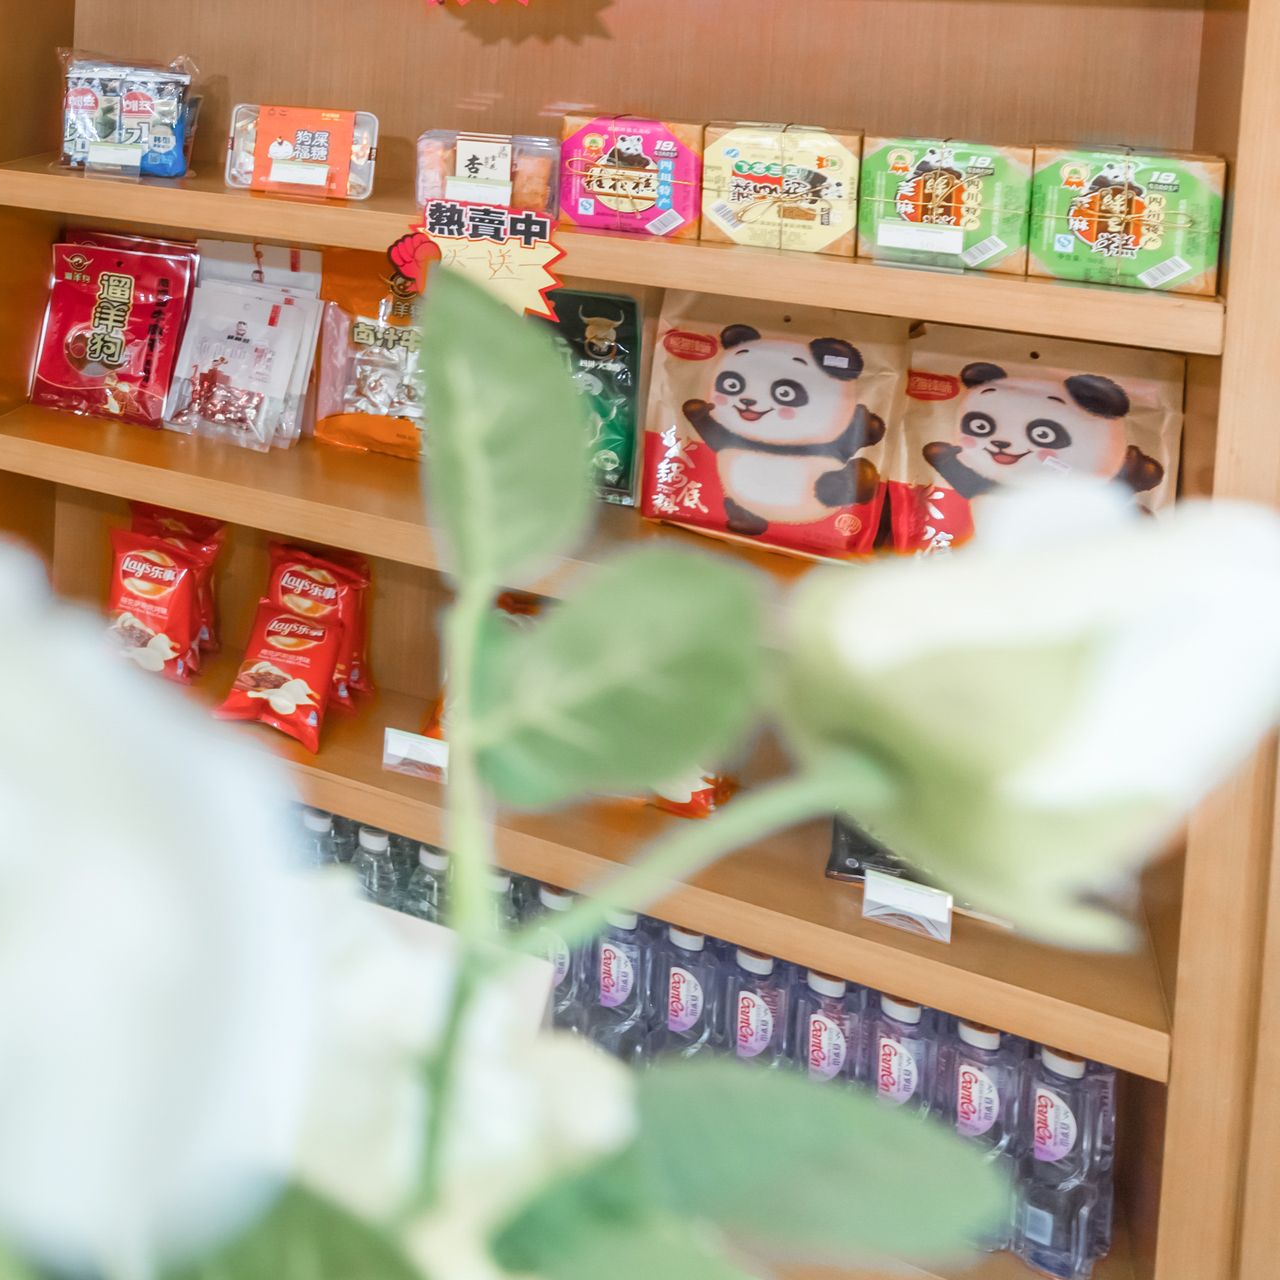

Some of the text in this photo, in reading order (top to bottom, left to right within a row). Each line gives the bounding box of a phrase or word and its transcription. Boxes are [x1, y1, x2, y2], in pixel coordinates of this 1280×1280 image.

[427, 200, 550, 246] 熱賣中
[87, 272, 134, 364] 遛洋狗
[351, 320, 423, 352] 卤汁牛
